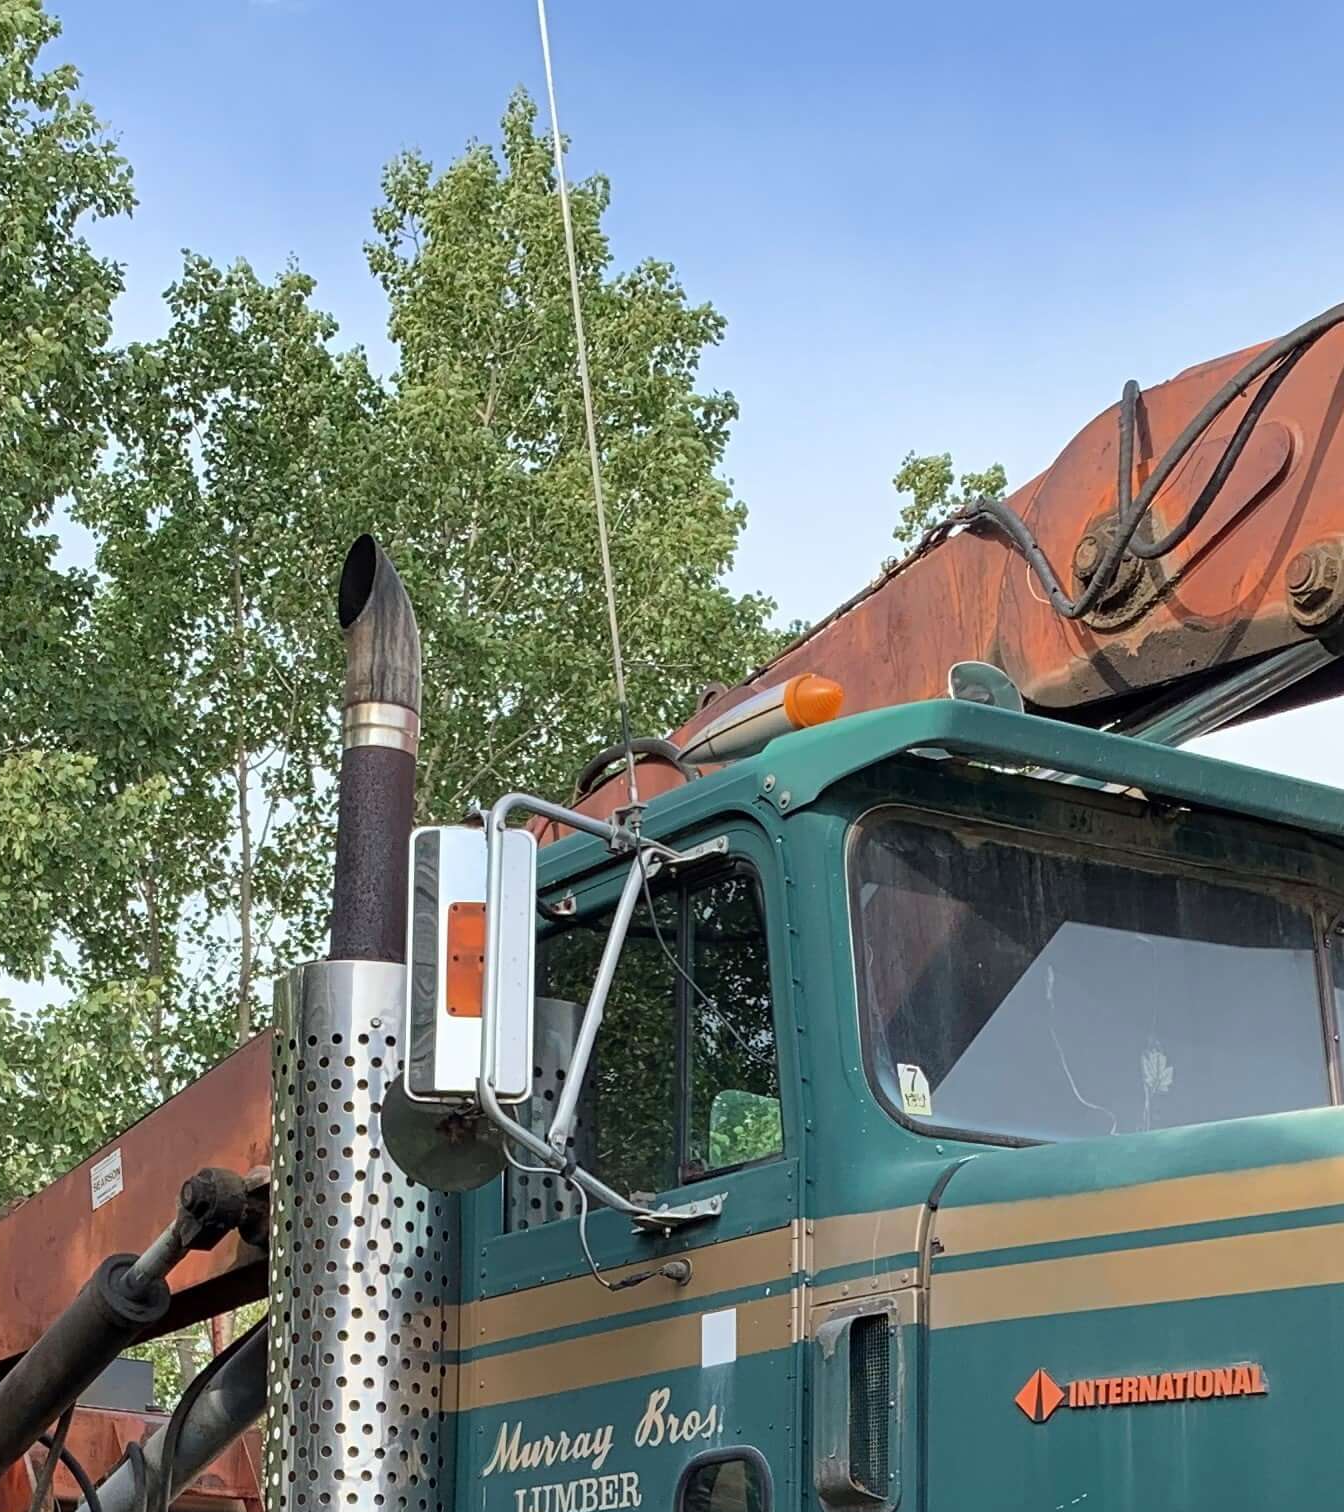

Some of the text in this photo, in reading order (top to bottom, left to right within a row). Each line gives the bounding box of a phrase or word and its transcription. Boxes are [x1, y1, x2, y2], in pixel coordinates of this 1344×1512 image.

[906, 1068, 918, 1092] 7
[1068, 1364, 1266, 1408] INTERNATIONAL
[482, 1386, 723, 1477] Murray Bros.
